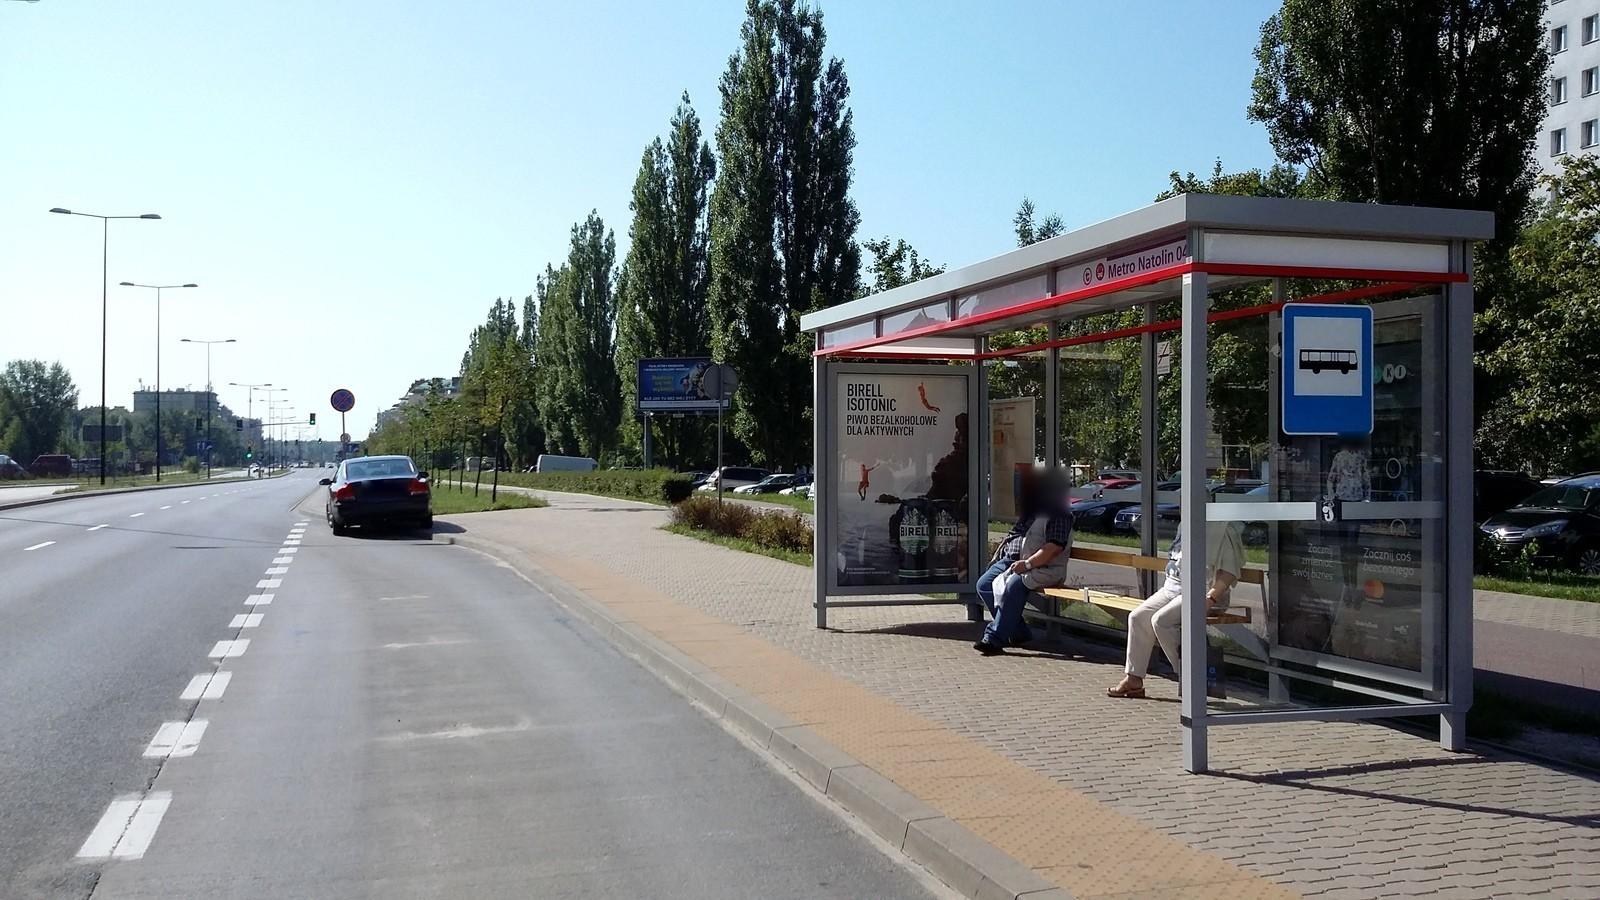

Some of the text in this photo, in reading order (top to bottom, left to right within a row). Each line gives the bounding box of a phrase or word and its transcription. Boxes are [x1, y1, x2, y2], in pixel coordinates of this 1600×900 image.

[1108, 262, 1136, 279] Metro
[1138, 249, 1174, 271] Natolin
[847, 383, 883, 397] BIRELL
[847, 398, 897, 412] ISOTONIC
[847, 415, 937, 426] PIWO BEZALKOHOLOWE
[847, 426, 914, 436] DLA AKTYWNYCH
